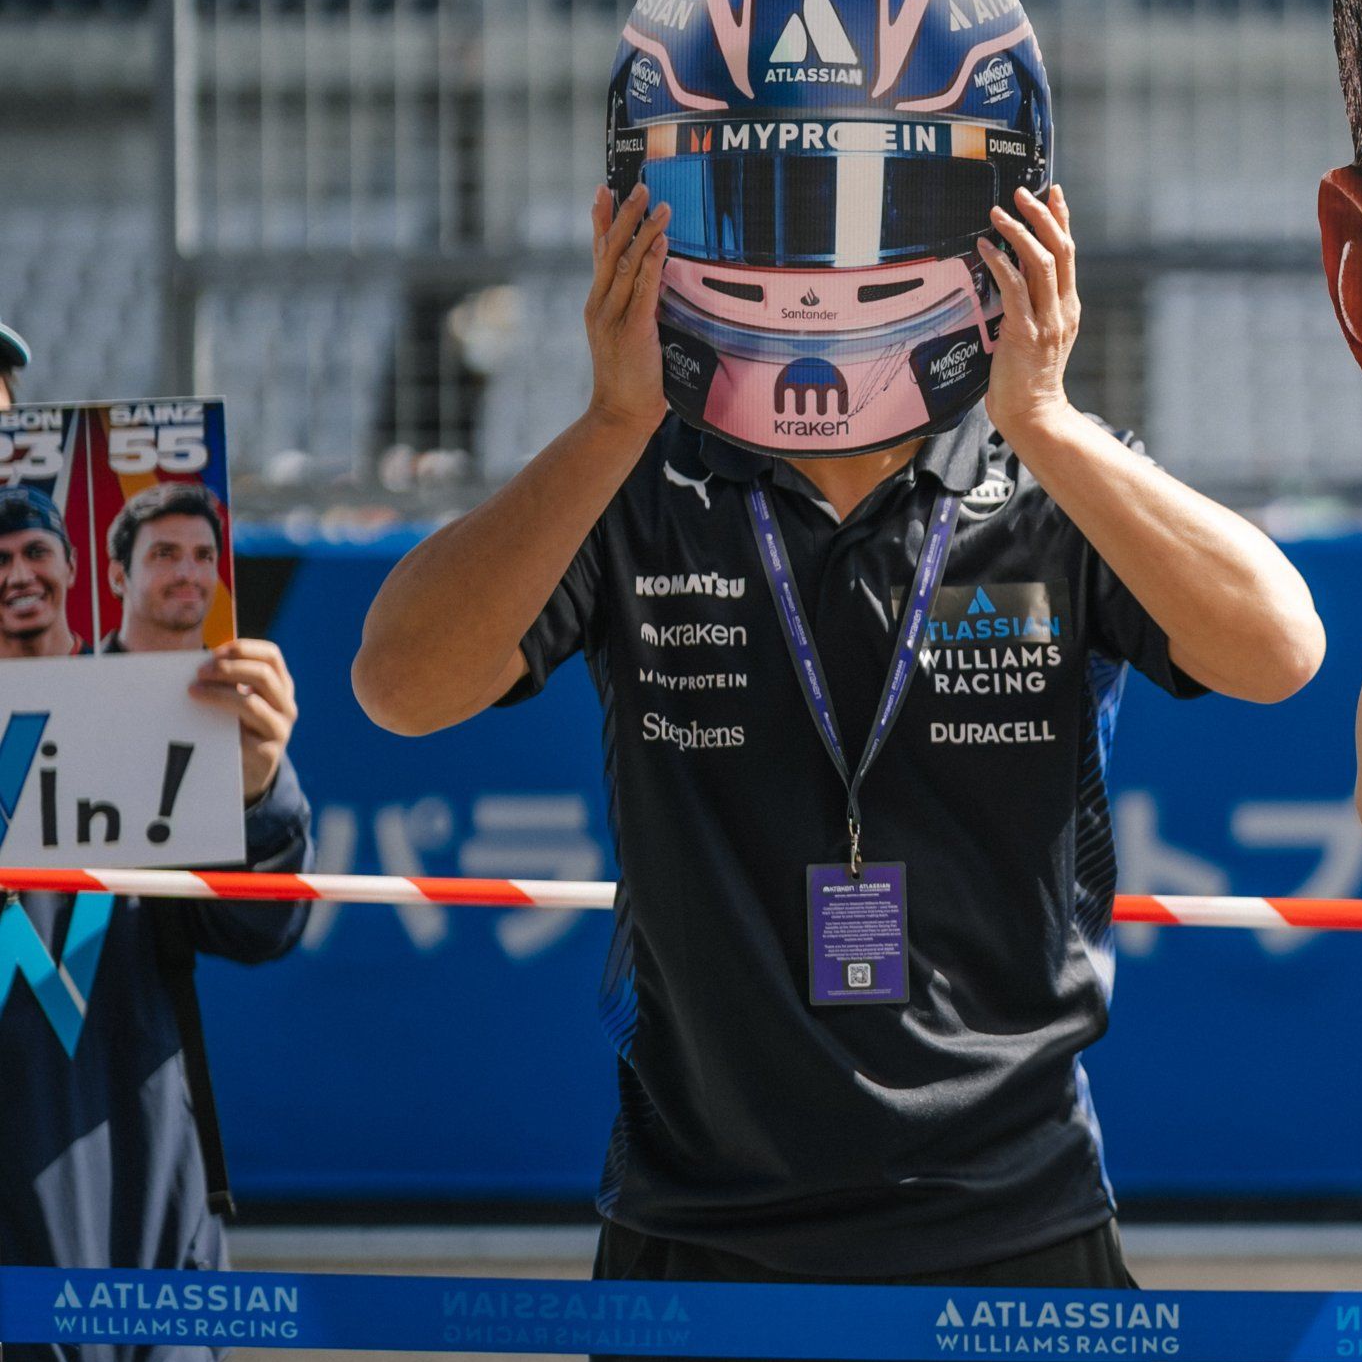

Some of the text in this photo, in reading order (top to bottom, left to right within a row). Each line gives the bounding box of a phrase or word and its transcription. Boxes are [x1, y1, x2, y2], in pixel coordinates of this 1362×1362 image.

[765, 68, 862, 85] ATLASSIAN
[616, 138, 644, 152] DURACELL
[989, 139, 1026, 156] DURACELL
[781, 308, 838, 320] Santander
[941, 361, 967, 380] VALLEY
[0, 408, 62, 431] BON
[109, 405, 204, 426] SAINZ
[774, 419, 849, 436] kraken
[109, 425, 208, 474] 55
[636, 572, 746, 598] KOMATSU
[661, 623, 747, 646] kraken
[925, 616, 1060, 641] TLASSIAN
[919, 645, 1061, 670] WILLIAMS
[656, 672, 747, 690] MYPROTEIN
[935, 671, 1046, 694] RACING
[642, 712, 745, 751] Stephens
[930, 720, 1056, 744] DURACELL
[89, 1282, 298, 1312] ATLASSIAN
[971, 1300, 1179, 1329] ATLASSIAN
